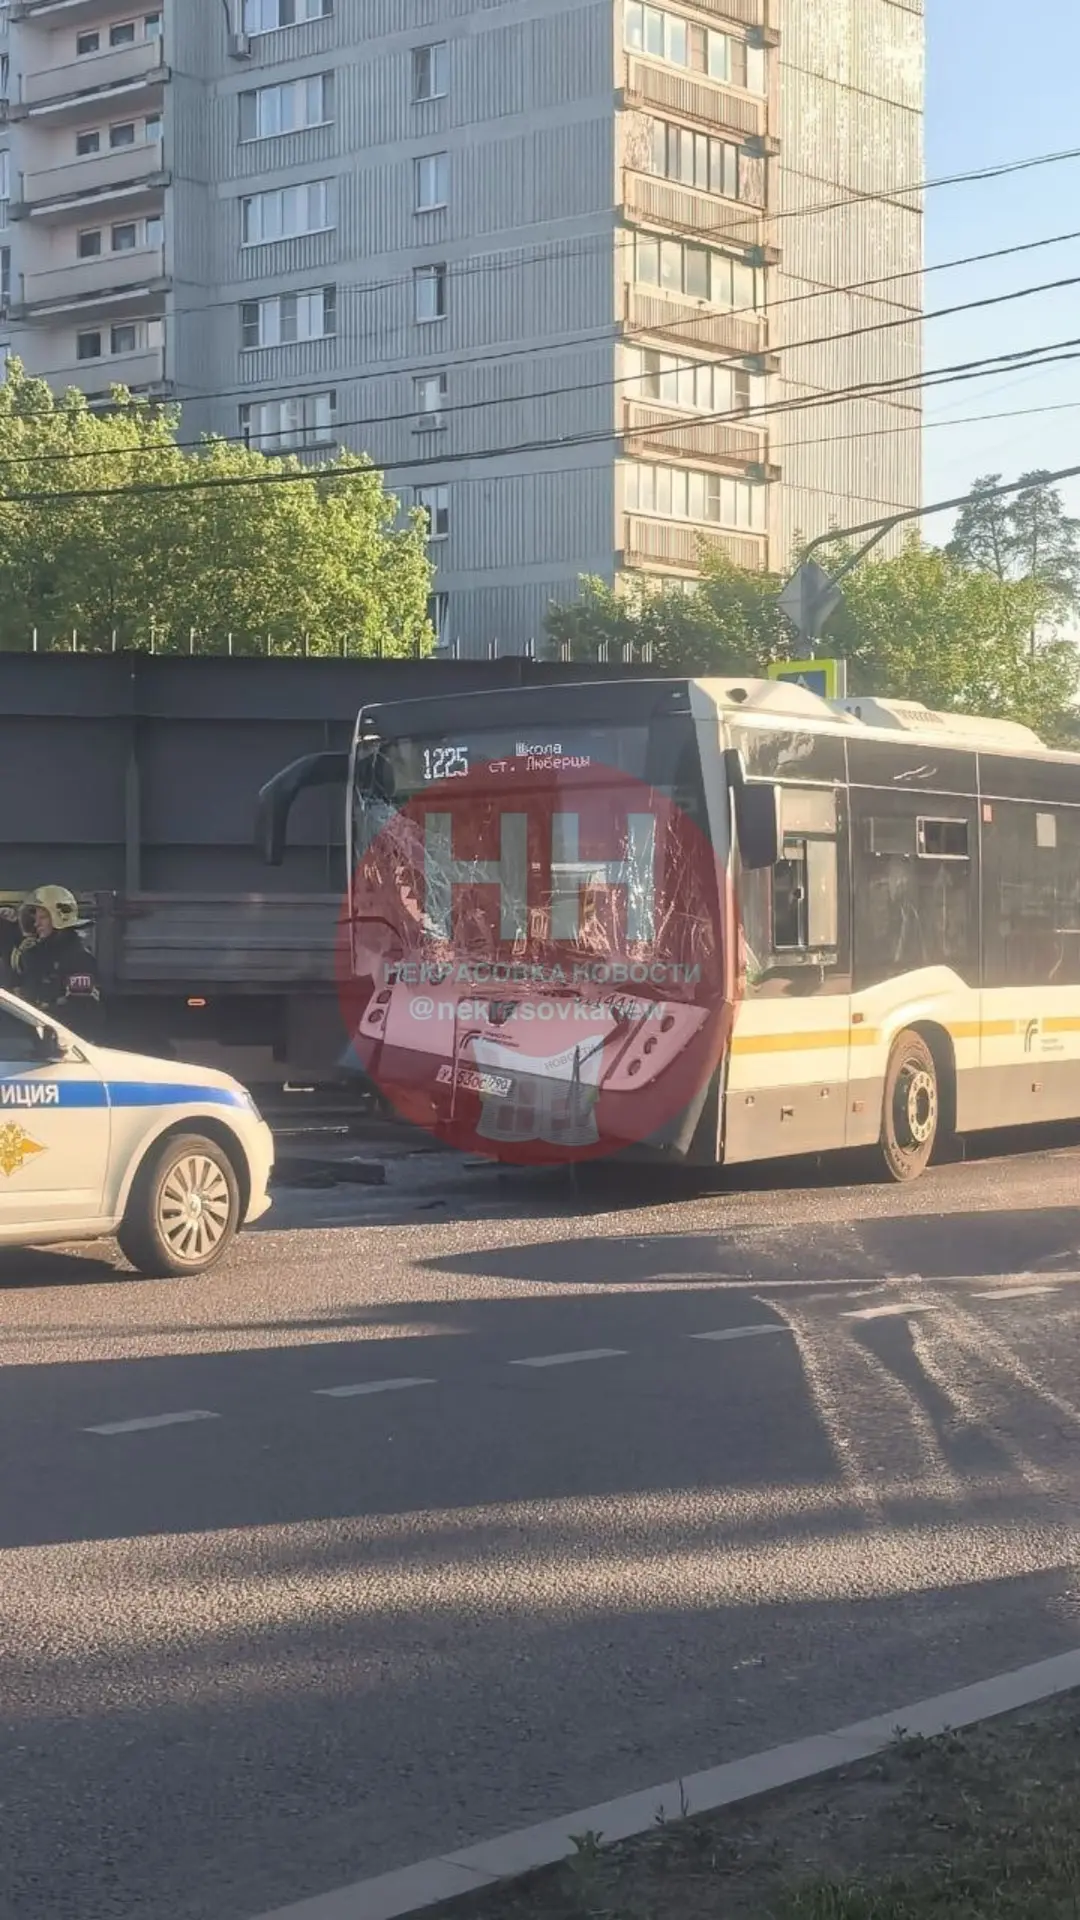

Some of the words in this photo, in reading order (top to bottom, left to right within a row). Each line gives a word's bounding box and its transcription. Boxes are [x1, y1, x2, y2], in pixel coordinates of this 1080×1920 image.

[516, 742, 562, 757] Школа
[423, 747, 469, 779] 1225
[488, 761, 516, 773] ст.
[526, 755, 591, 771] Люберцы
